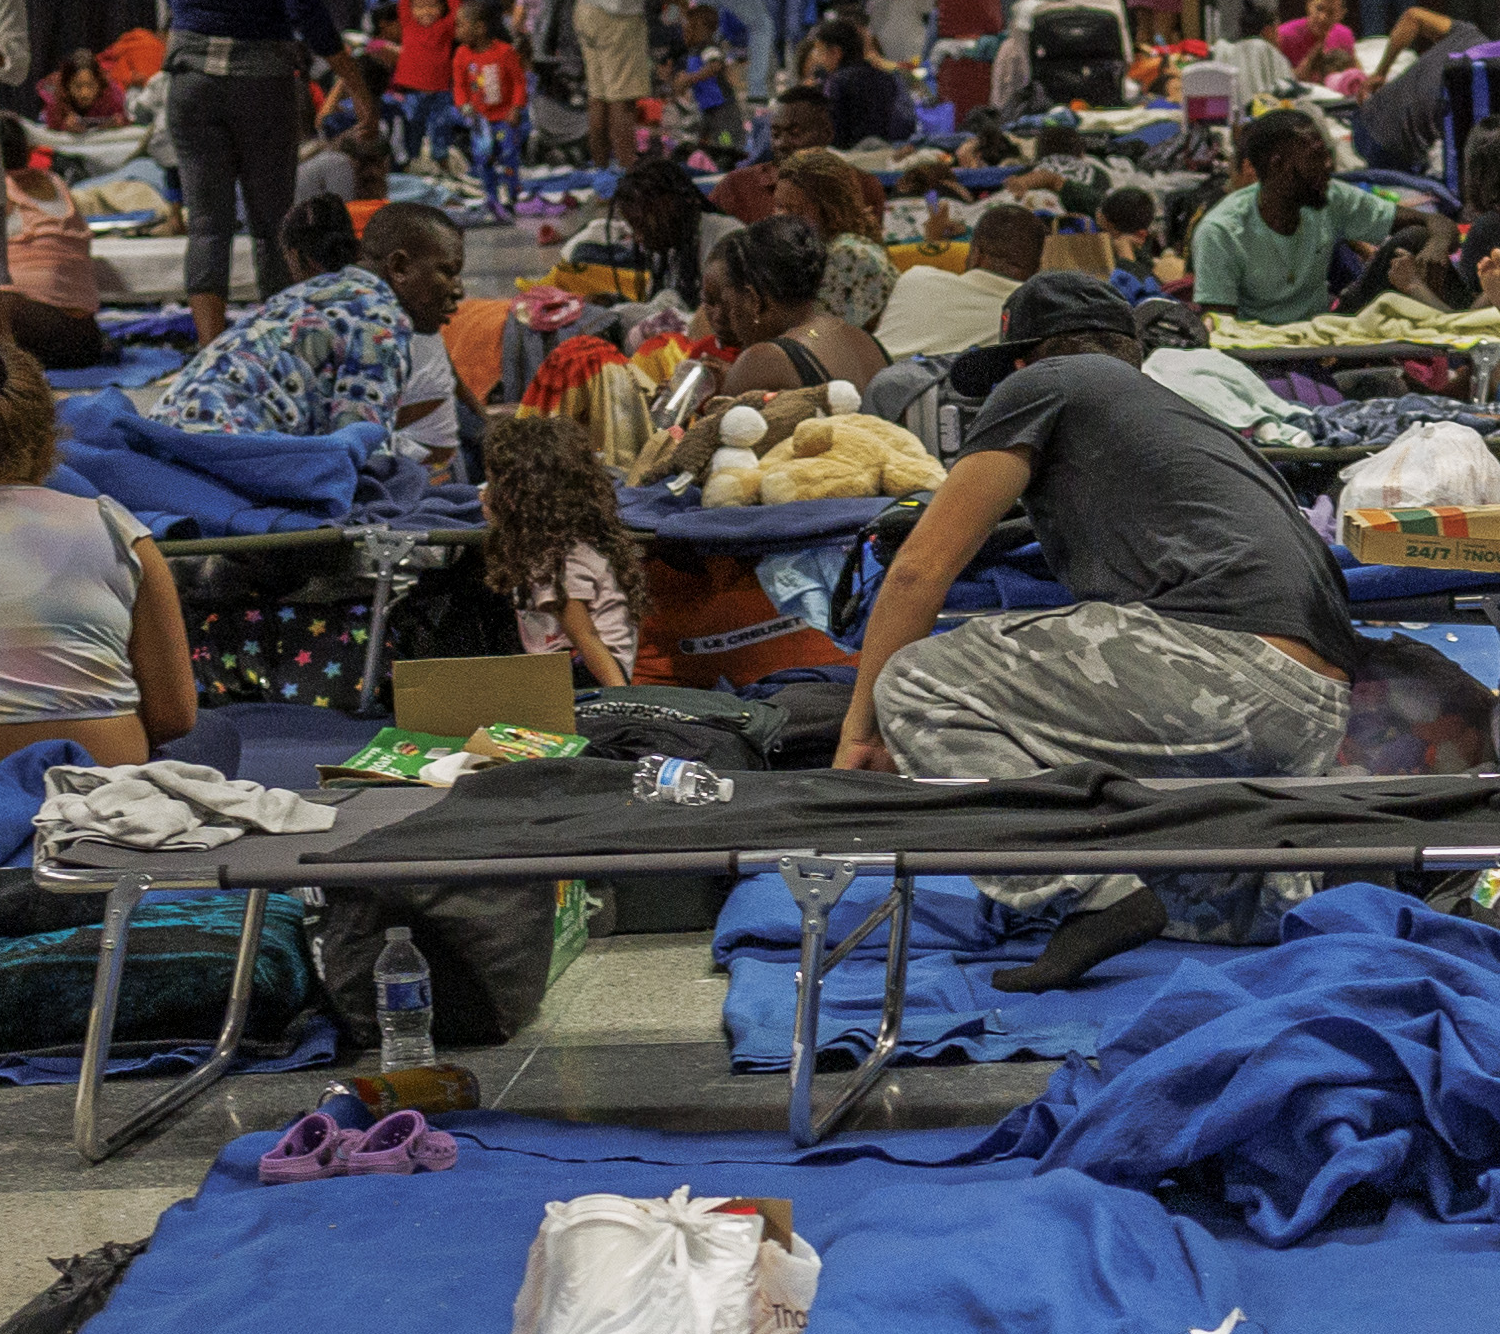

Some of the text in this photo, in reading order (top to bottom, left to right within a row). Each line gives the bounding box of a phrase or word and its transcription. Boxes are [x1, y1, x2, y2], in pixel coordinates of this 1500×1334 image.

[1405, 545, 1451, 560] 24/7
[702, 616, 802, 649] LE CREUSET
